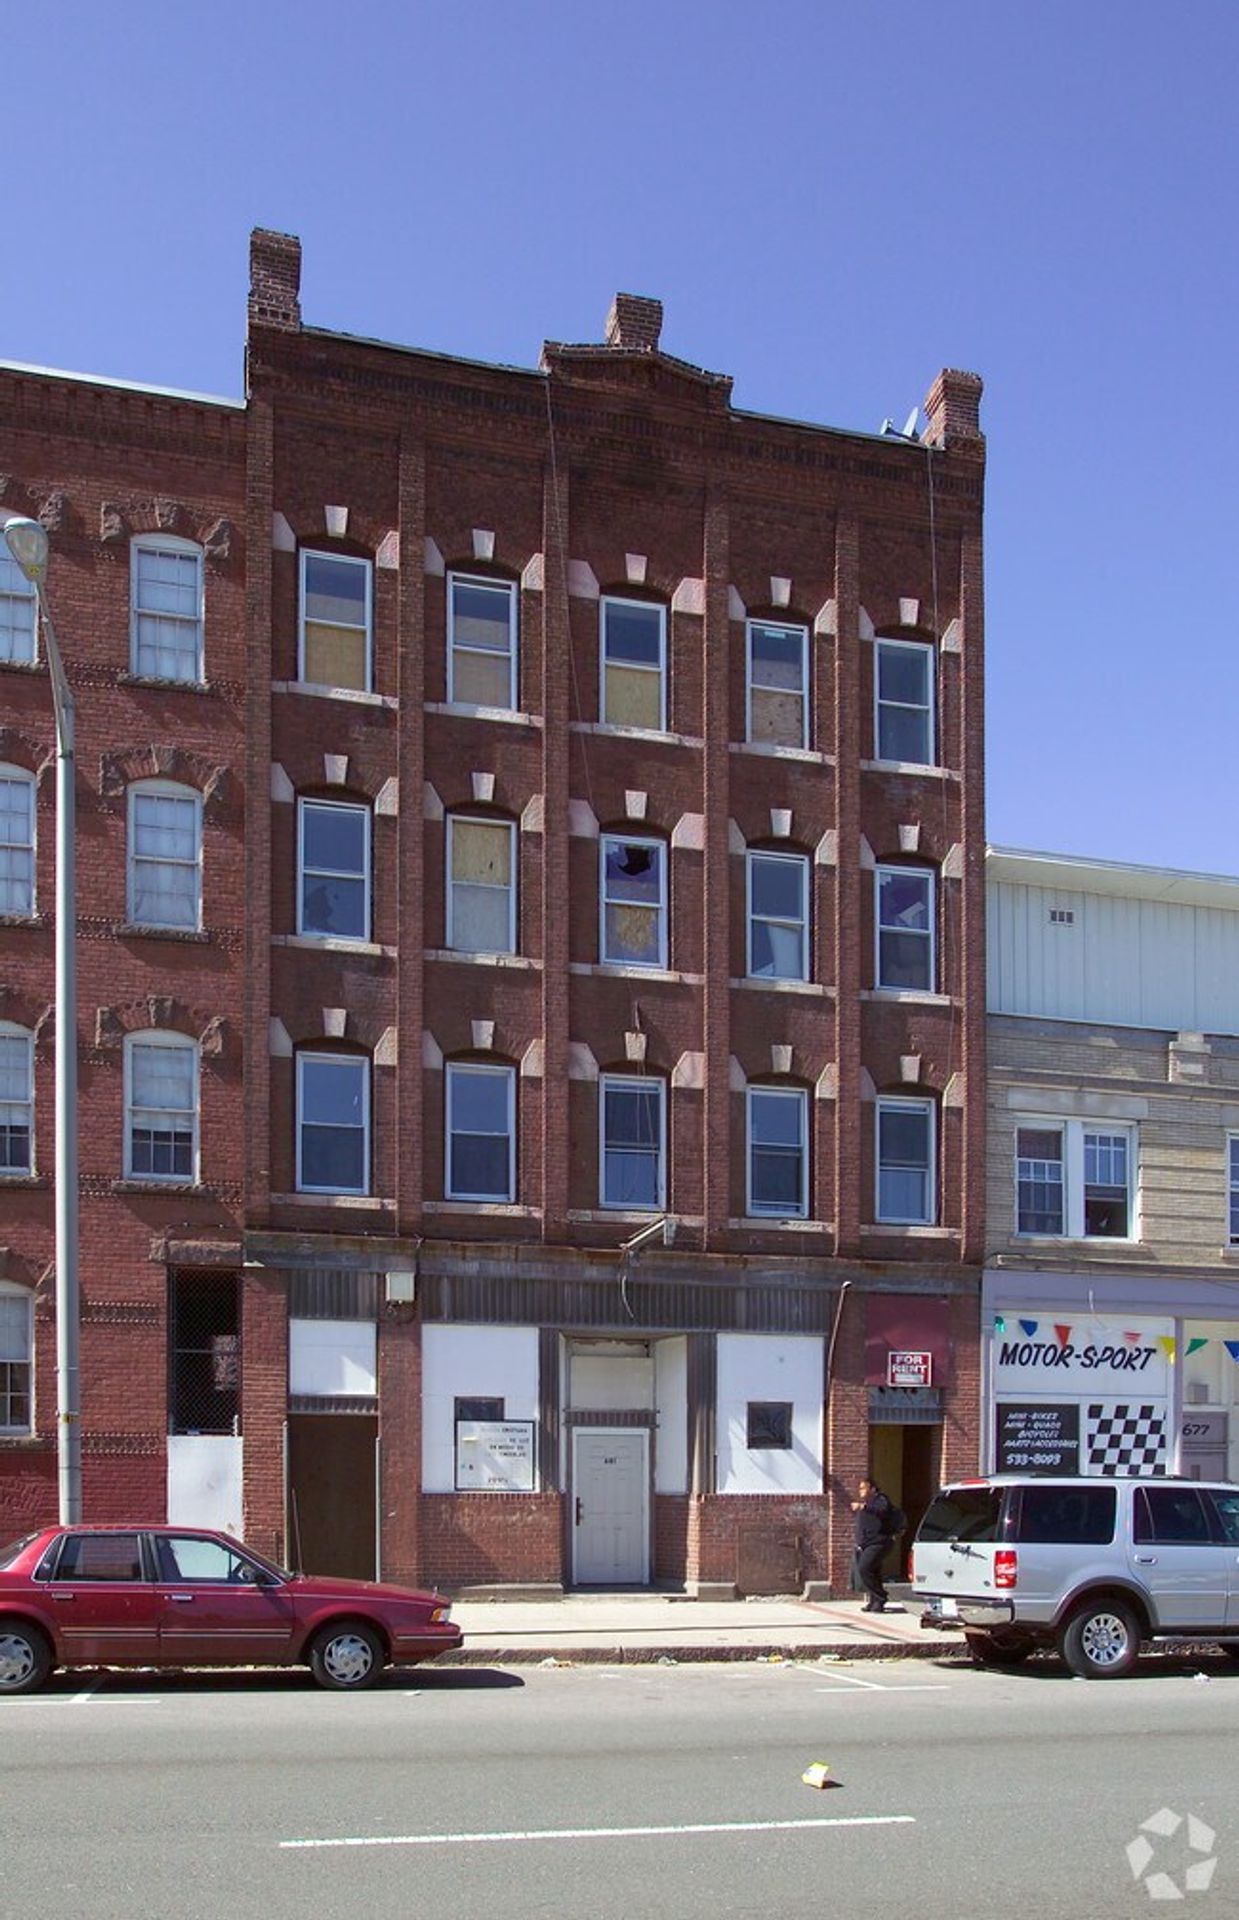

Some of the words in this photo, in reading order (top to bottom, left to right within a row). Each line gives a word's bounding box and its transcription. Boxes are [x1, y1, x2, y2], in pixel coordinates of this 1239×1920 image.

[896, 1355, 922, 1365] FOR
[999, 1342, 1157, 1371] MOTOR-SPORT
[892, 1364, 927, 1374] RENT
[1182, 1423, 1210, 1437] 677
